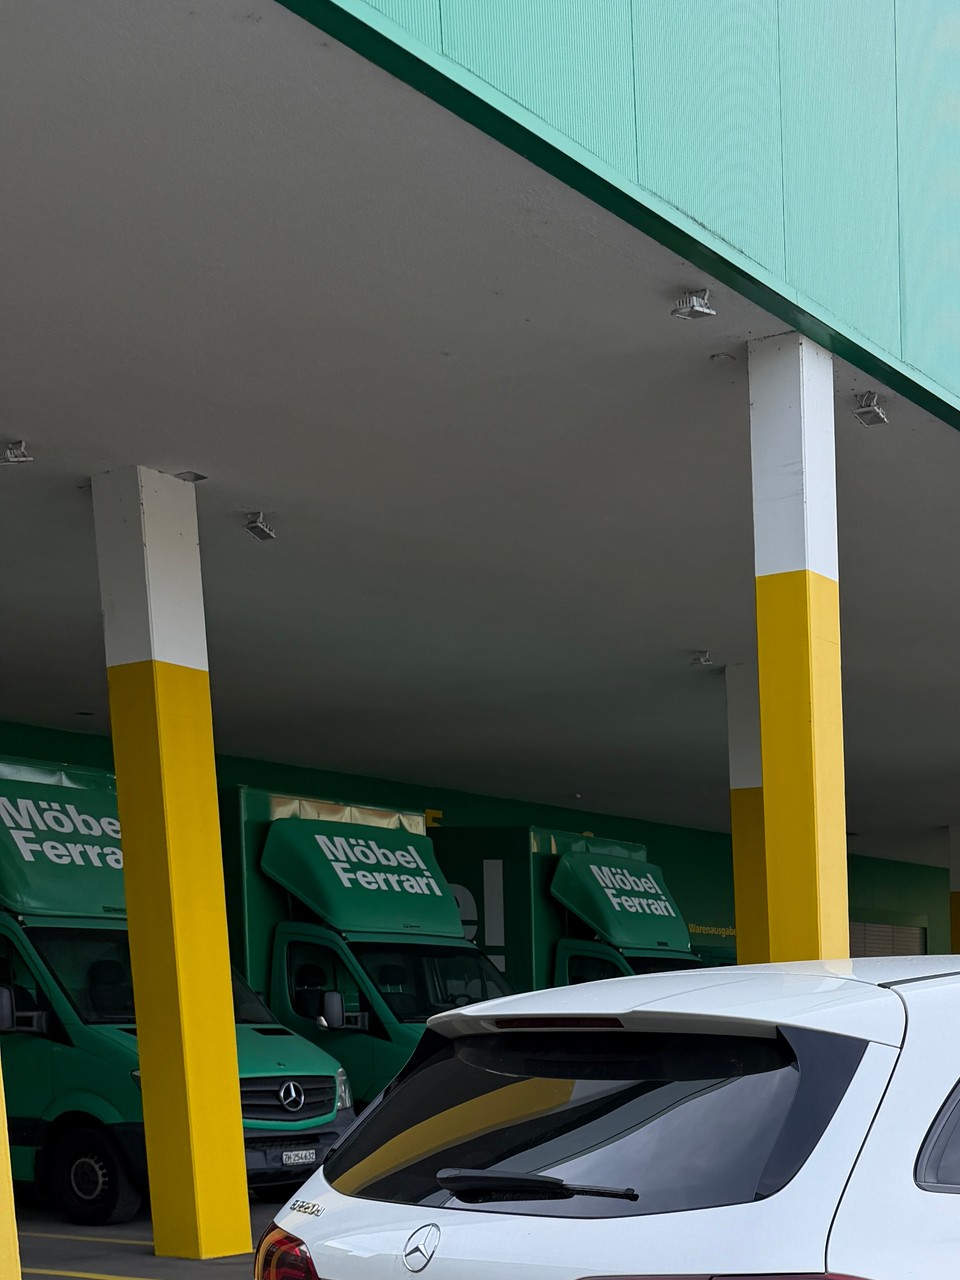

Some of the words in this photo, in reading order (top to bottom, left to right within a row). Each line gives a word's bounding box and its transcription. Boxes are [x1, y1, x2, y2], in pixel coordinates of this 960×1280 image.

[0, 796, 122, 839] Möbe
[9, 829, 124, 870] Ferra
[314, 834, 427, 870] Möbel
[331, 861, 443, 896] Ferrari
[589, 864, 663, 895] Möbel
[604, 888, 677, 917] Ferrari
